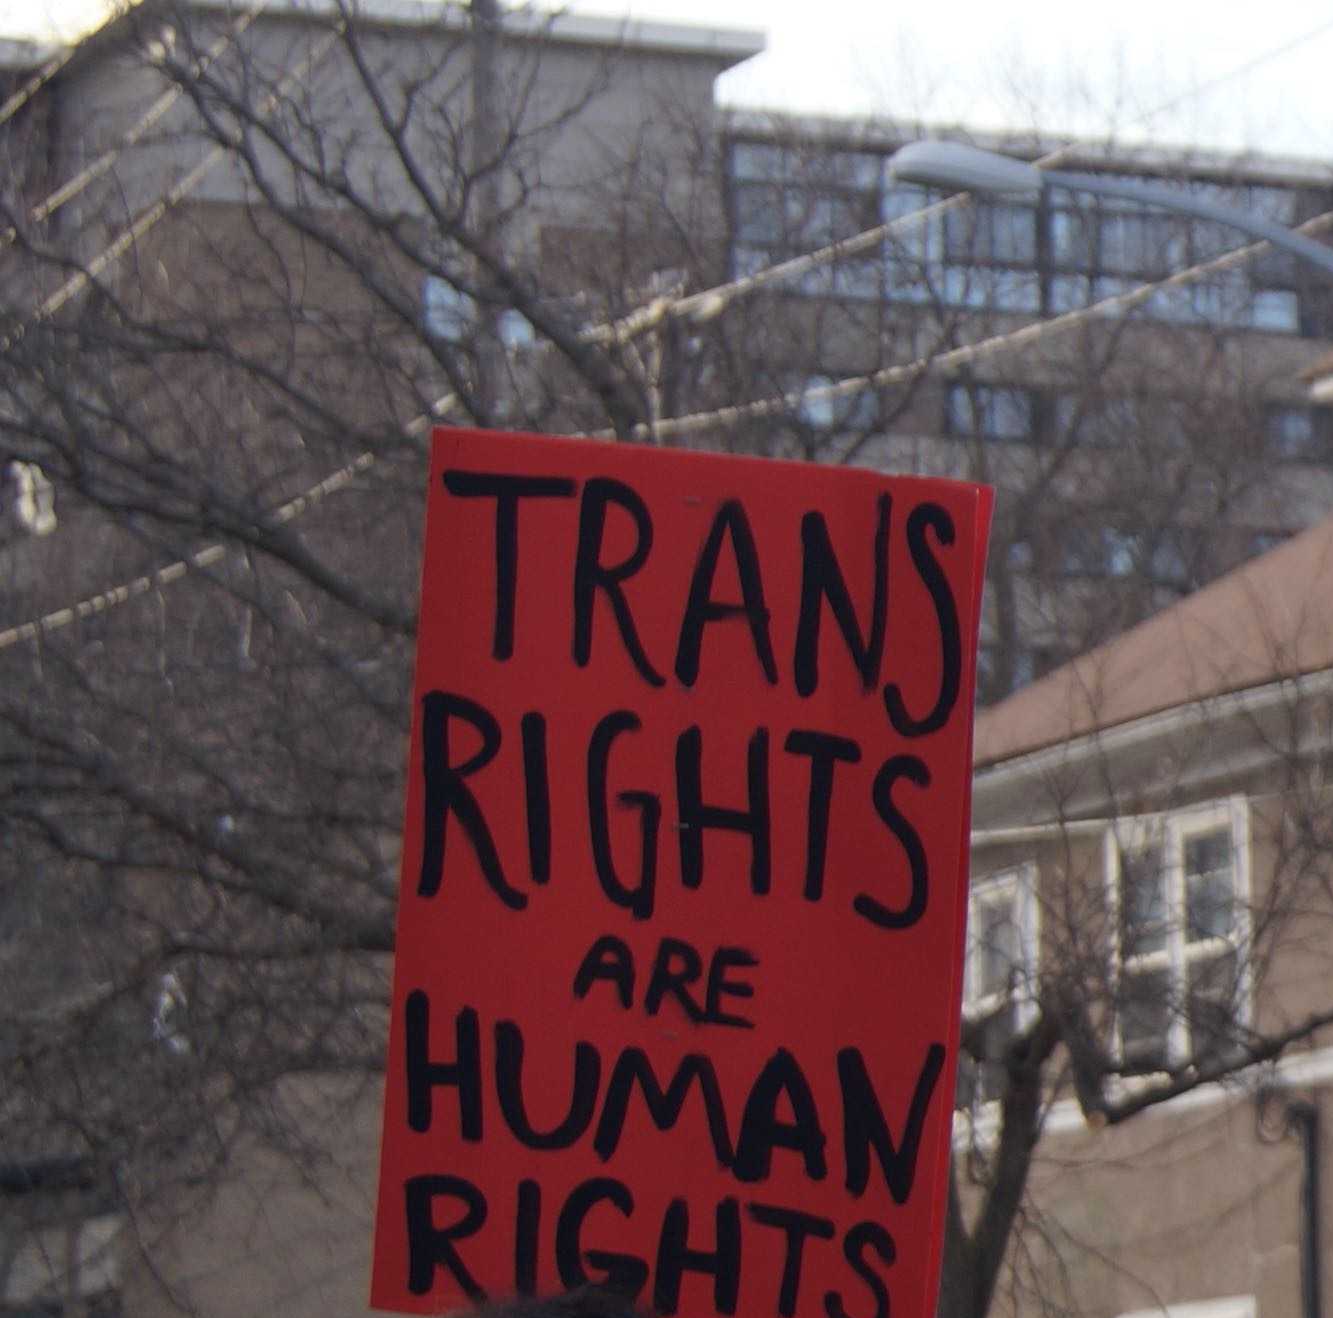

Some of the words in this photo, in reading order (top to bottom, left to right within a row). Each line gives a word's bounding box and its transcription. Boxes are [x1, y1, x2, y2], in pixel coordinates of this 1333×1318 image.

[443, 470, 963, 738] TRANS
[417, 689, 931, 931] RIGHTS
[574, 935, 760, 1030] ARE
[406, 991, 946, 1205] HUMAN
